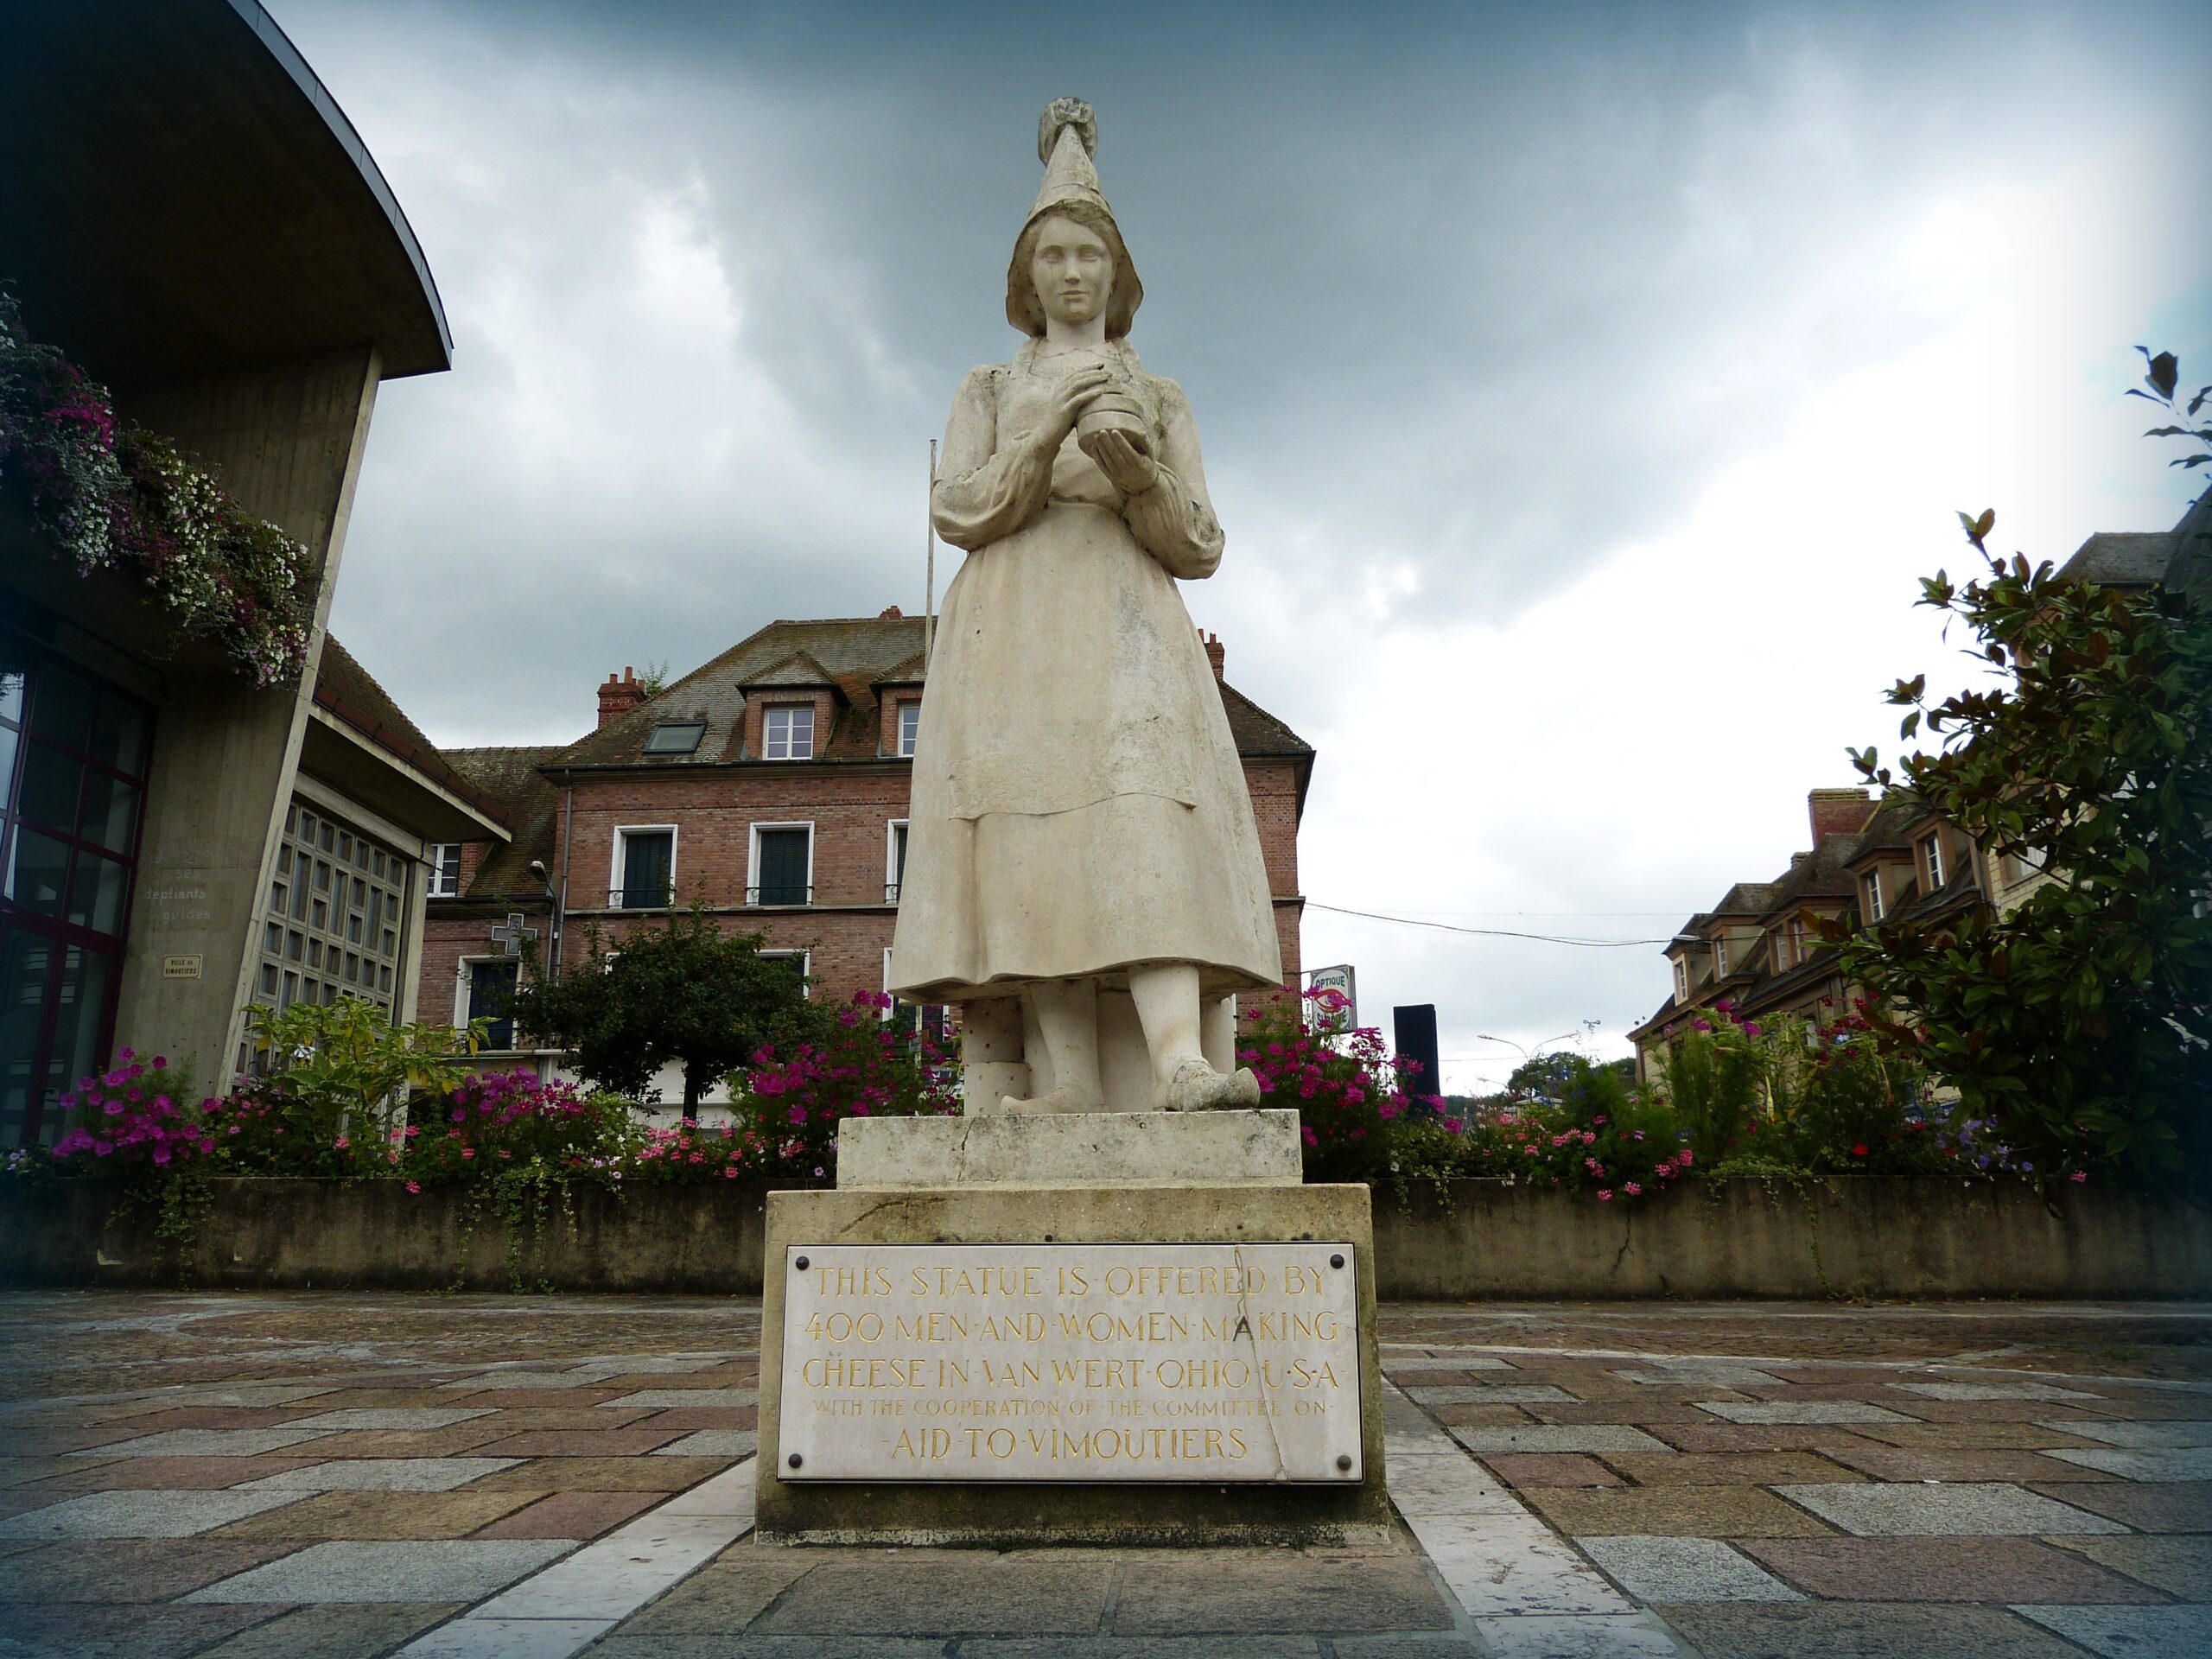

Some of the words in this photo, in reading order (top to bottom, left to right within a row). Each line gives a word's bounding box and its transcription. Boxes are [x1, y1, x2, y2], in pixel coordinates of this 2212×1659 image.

[1316, 976, 1345, 987] OPTIQUE
[814, 1268, 892, 1297] THIS
[911, 1268, 1041, 1298] STATUE
[1058, 1267, 1089, 1296] IS
[1106, 1266, 1266, 1296] OFFERED
[1285, 1266, 1326, 1295] BY
[804, 1313, 884, 1342] 400
[895, 1313, 968, 1342] MEN
[980, 1313, 1046, 1342] AND
[1058, 1313, 1187, 1342] WOMEN
[1203, 1312, 1338, 1342] MAKING
[803, 1359, 926, 1389] CHEESE
[938, 1359, 969, 1389] IN
[982, 1359, 1039, 1389] VAN
[1052, 1359, 1145, 1389] WERT
[1156, 1359, 1250, 1389] OHIO
[812, 1400, 862, 1415] WITH
[870, 1400, 904, 1416] THE
[913, 1399, 1058, 1416] COOPERATION
[1070, 1401, 1094, 1416] OF
[1108, 1401, 1149, 1417] THE
[1153, 1400, 1281, 1417] COMMITTEE
[1294, 1400, 1326, 1417] ON
[890, 1428, 951, 1459] AID
[964, 1428, 1016, 1459] TO
[1027, 1428, 1247, 1460] VIMOUTIERS
